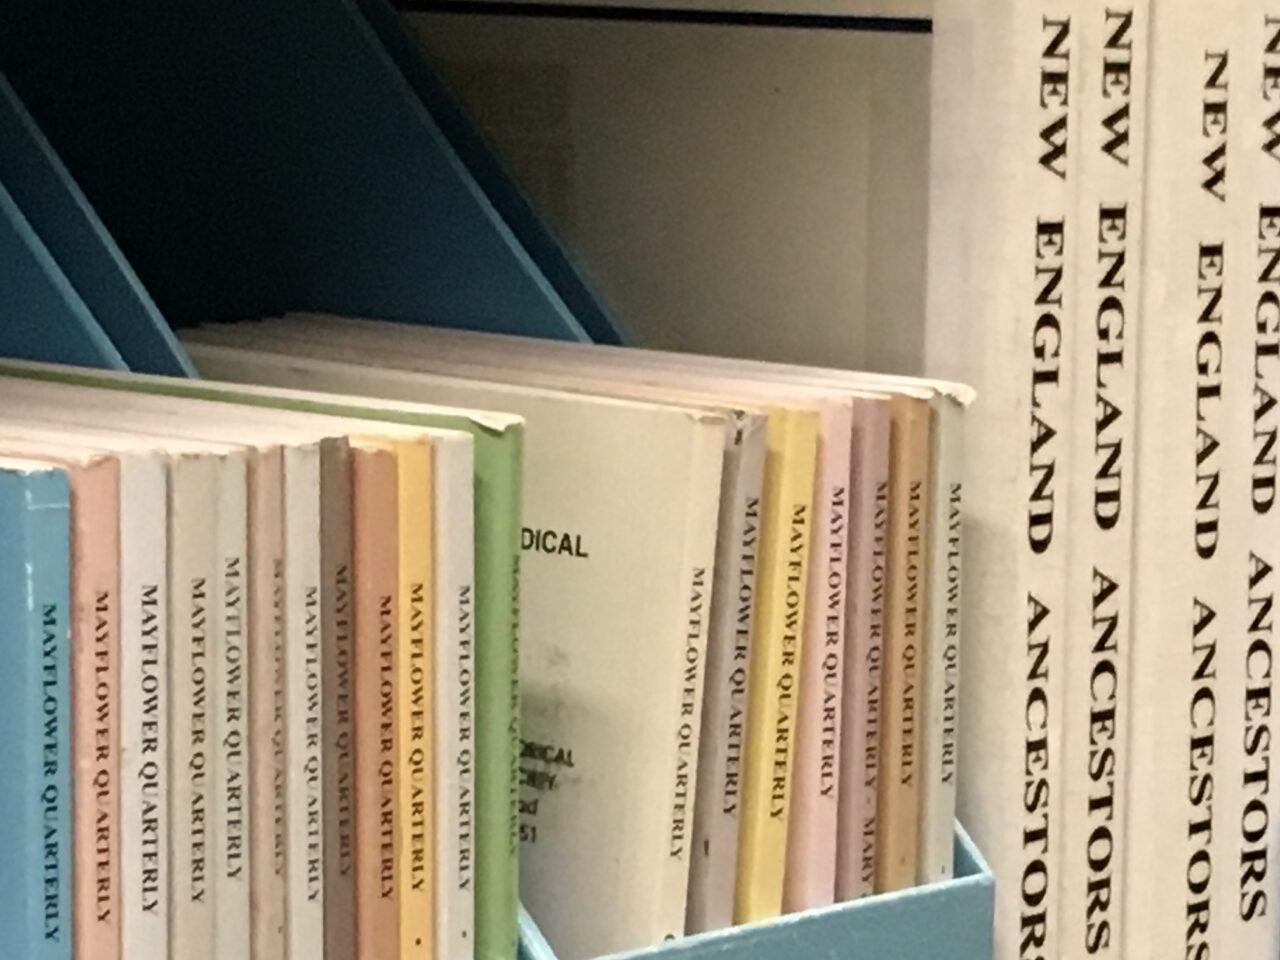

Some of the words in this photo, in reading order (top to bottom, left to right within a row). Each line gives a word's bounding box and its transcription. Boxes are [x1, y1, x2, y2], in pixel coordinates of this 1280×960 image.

[1038, 14, 1071, 181] NEW
[1101, 8, 1133, 167] NEW
[1200, 48, 1229, 203] NEW
[1028, 215, 1064, 555] ENGLAND
[1094, 202, 1127, 531] ENGLAND
[1194, 242, 1224, 559] ENGLAND
[521, 527, 588, 558] DICAL
[734, 497, 758, 660] MAYFLOWER
[782, 504, 806, 666] MAYFLOWER
[826, 486, 844, 646] MAYFLOWER
[869, 481, 887, 638] MAYFLOWER
[904, 481, 921, 637] MAYFLOWER
[945, 482, 961, 637] MAYFLOWER
[42, 604, 58, 777] MAYFLOWER
[95, 591, 110, 763] MAYFLOWER
[141, 584, 158, 755] MAYFLOWER
[191, 578, 206, 745] MAYFLOWER
[224, 556, 241, 722] MAYFLOWER
[305, 586, 318, 748] MAYFLOWER
[335, 564, 348, 725] MAYFLOWER
[379, 596, 392, 753] MAYFLOWER
[410, 583, 424, 743] MAYFLOWER
[458, 584, 470, 743] MAYFLOWER
[681, 567, 705, 716] MAYFLOWER
[865, 646, 881, 787] QUARTERLY
[901, 644, 917, 788] QUARTERLY
[941, 645, 957, 786] QUARTERLY
[670, 723, 693, 860] QUARTERLY
[723, 668, 747, 820] QUARTERLY
[770, 672, 793, 822] QUARTERLY
[820, 652, 839, 798] QUARTERLY
[1085, 566, 1119, 954] ANCESTORS
[1240, 550, 1274, 922] ANCESTORS
[41, 784, 60, 943] QUARTERLY
[92, 769, 111, 927] QUARTERLY
[138, 760, 158, 915] QUARTERLY
[189, 751, 206, 904] QUARTERLY
[222, 729, 242, 882] QUARTERLY
[304, 756, 320, 902] QUARTERLY
[335, 732, 351, 877] QUARTERLY
[378, 760, 394, 901] QUARTERLY
[408, 749, 425, 892] QUARTERLY
[457, 749, 471, 890] QUARTERLY
